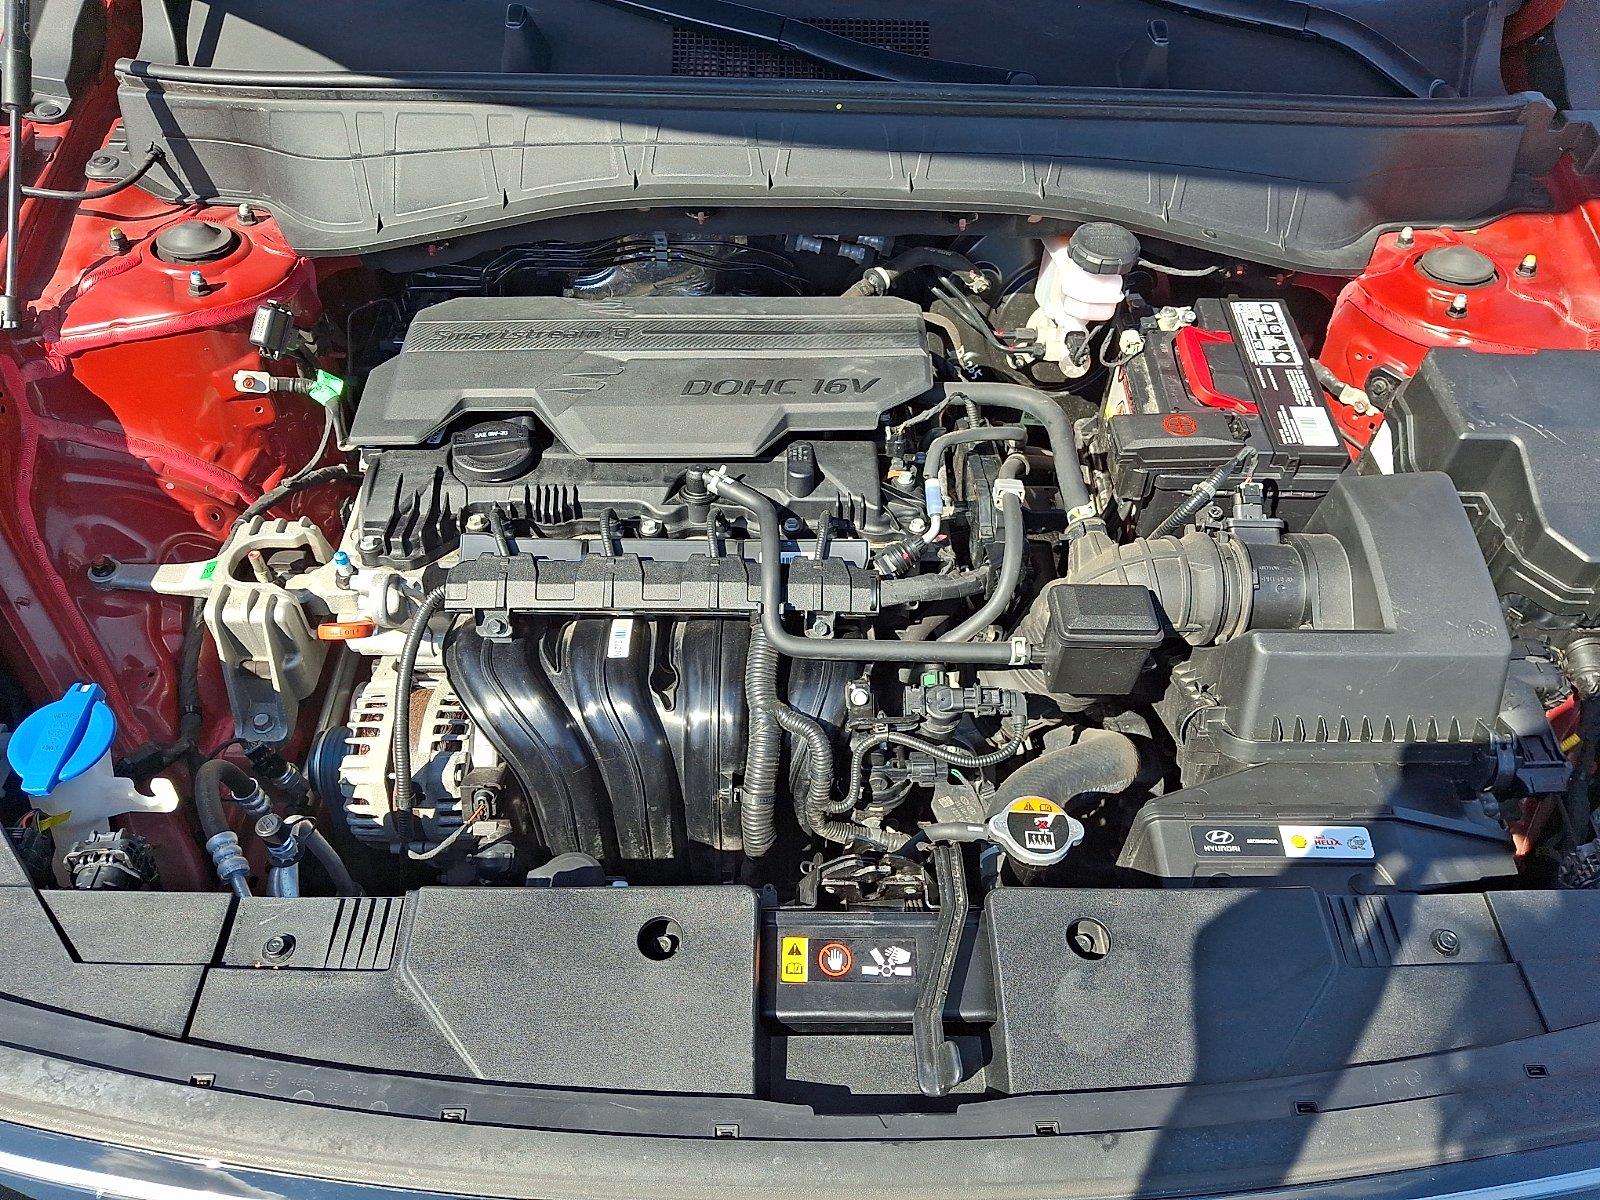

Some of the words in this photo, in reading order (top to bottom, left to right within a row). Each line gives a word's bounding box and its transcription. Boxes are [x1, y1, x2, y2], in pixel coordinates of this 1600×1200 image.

[431, 328, 602, 342] Smartstream
[680, 378, 803, 397] DOHC
[811, 377, 882, 395] 16V
[1203, 845, 1241, 853] HYUNDAI
